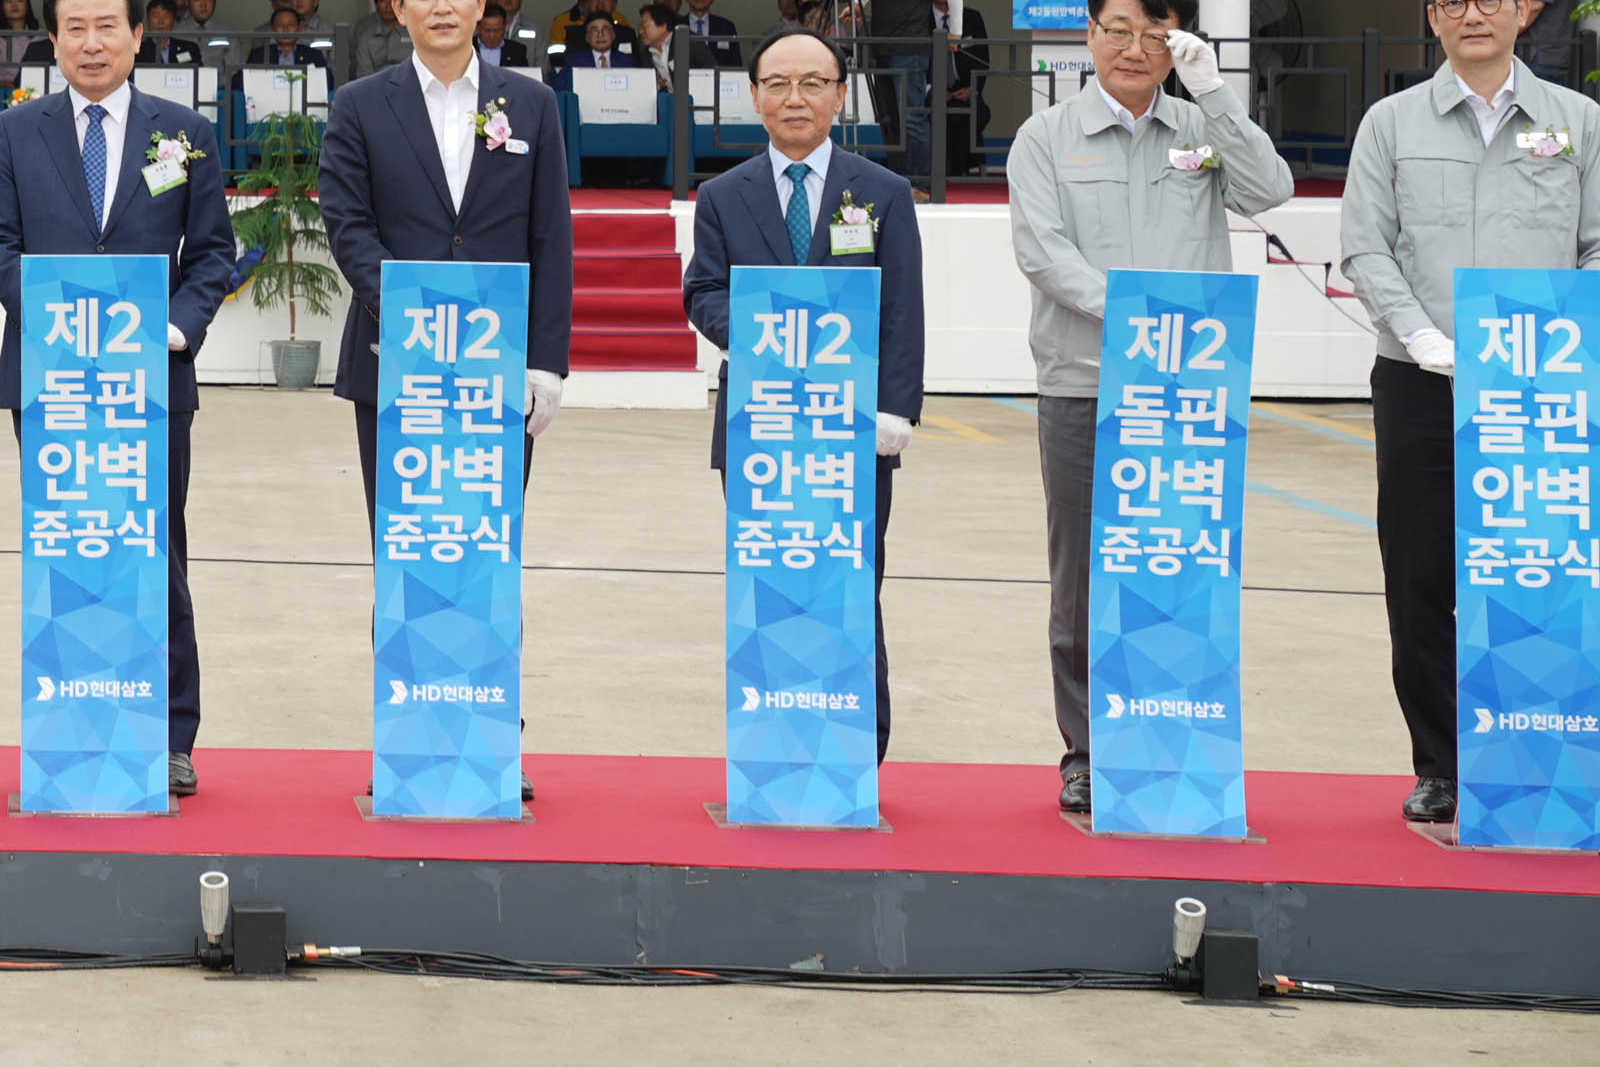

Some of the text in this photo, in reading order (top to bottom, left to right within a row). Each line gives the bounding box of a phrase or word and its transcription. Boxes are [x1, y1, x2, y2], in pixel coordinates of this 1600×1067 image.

[45, 298, 141, 357] 제2
[403, 305, 500, 362] 제2
[752, 310, 850, 368] 제2
[1125, 313, 1227, 373] 제2
[1479, 314, 1582, 376] 제2
[39, 369, 146, 430] 돌핀
[395, 375, 503, 434] 돌핀
[744, 381, 854, 440] 돌핀
[1114, 385, 1227, 446] 돌핀
[1473, 390, 1589, 453] 돌핀
[38, 441, 146, 501] 안벽
[394, 445, 503, 507] 안벽
[743, 451, 854, 512] 안벽
[1111, 456, 1225, 519] 안벽
[1473, 465, 1589, 529] 안벽
[30, 510, 154, 558] 준공식
[384, 514, 509, 563] 준공식
[734, 520, 861, 568] 준공식
[1099, 527, 1229, 576] 준공식
[1465, 538, 1600, 588] 준공식
[60, 680, 152, 699] HD현대삼호
[413, 684, 505, 704] HD현대삼호
[765, 691, 859, 711] HD현대삼호
[1130, 698, 1226, 719] HD현대삼호
[1499, 713, 1600, 733] HD현대삼호
